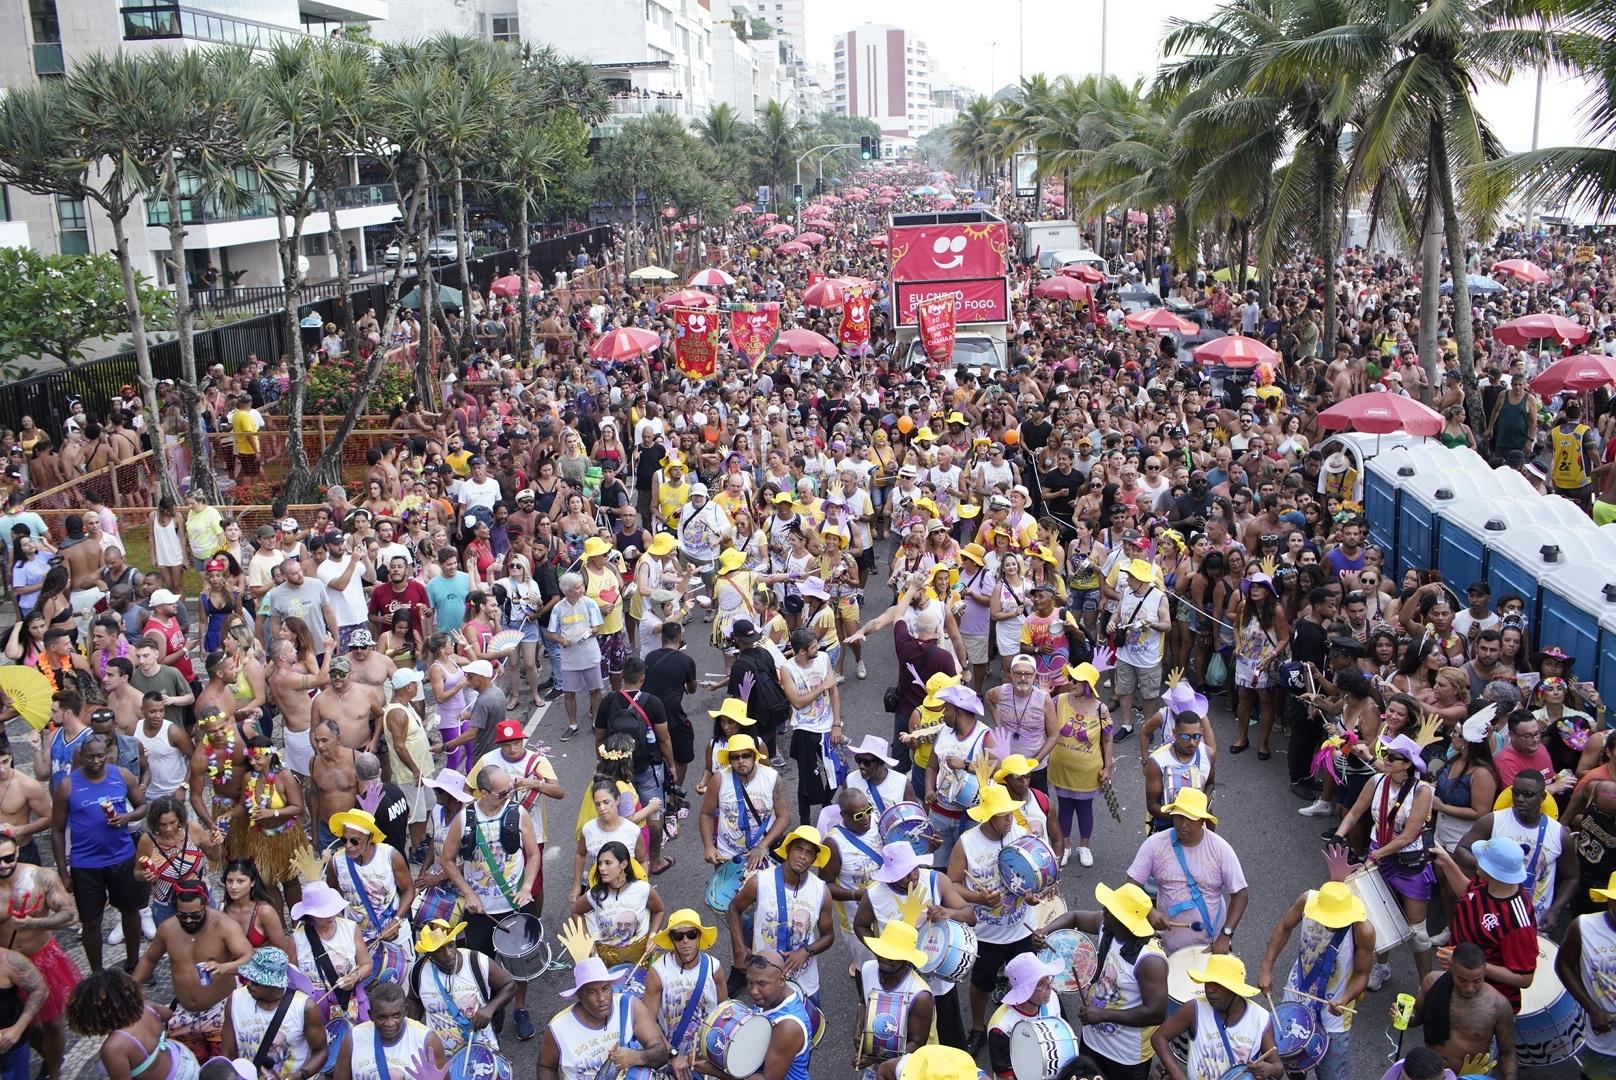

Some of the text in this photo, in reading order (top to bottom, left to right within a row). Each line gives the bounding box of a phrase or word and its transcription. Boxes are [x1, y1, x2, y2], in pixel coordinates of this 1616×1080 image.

[910, 294, 923, 302] EU
[965, 300, 996, 310] FOGO.
[928, 336, 953, 346] CHAMAR
[388, 798, 407, 822] APOIO
[1578, 830, 1605, 864] 23
[972, 867, 995, 878] SIM
[239, 1032, 260, 1044] SIM
[589, 1039, 599, 1047] DE
[602, 1032, 620, 1042] JANE
